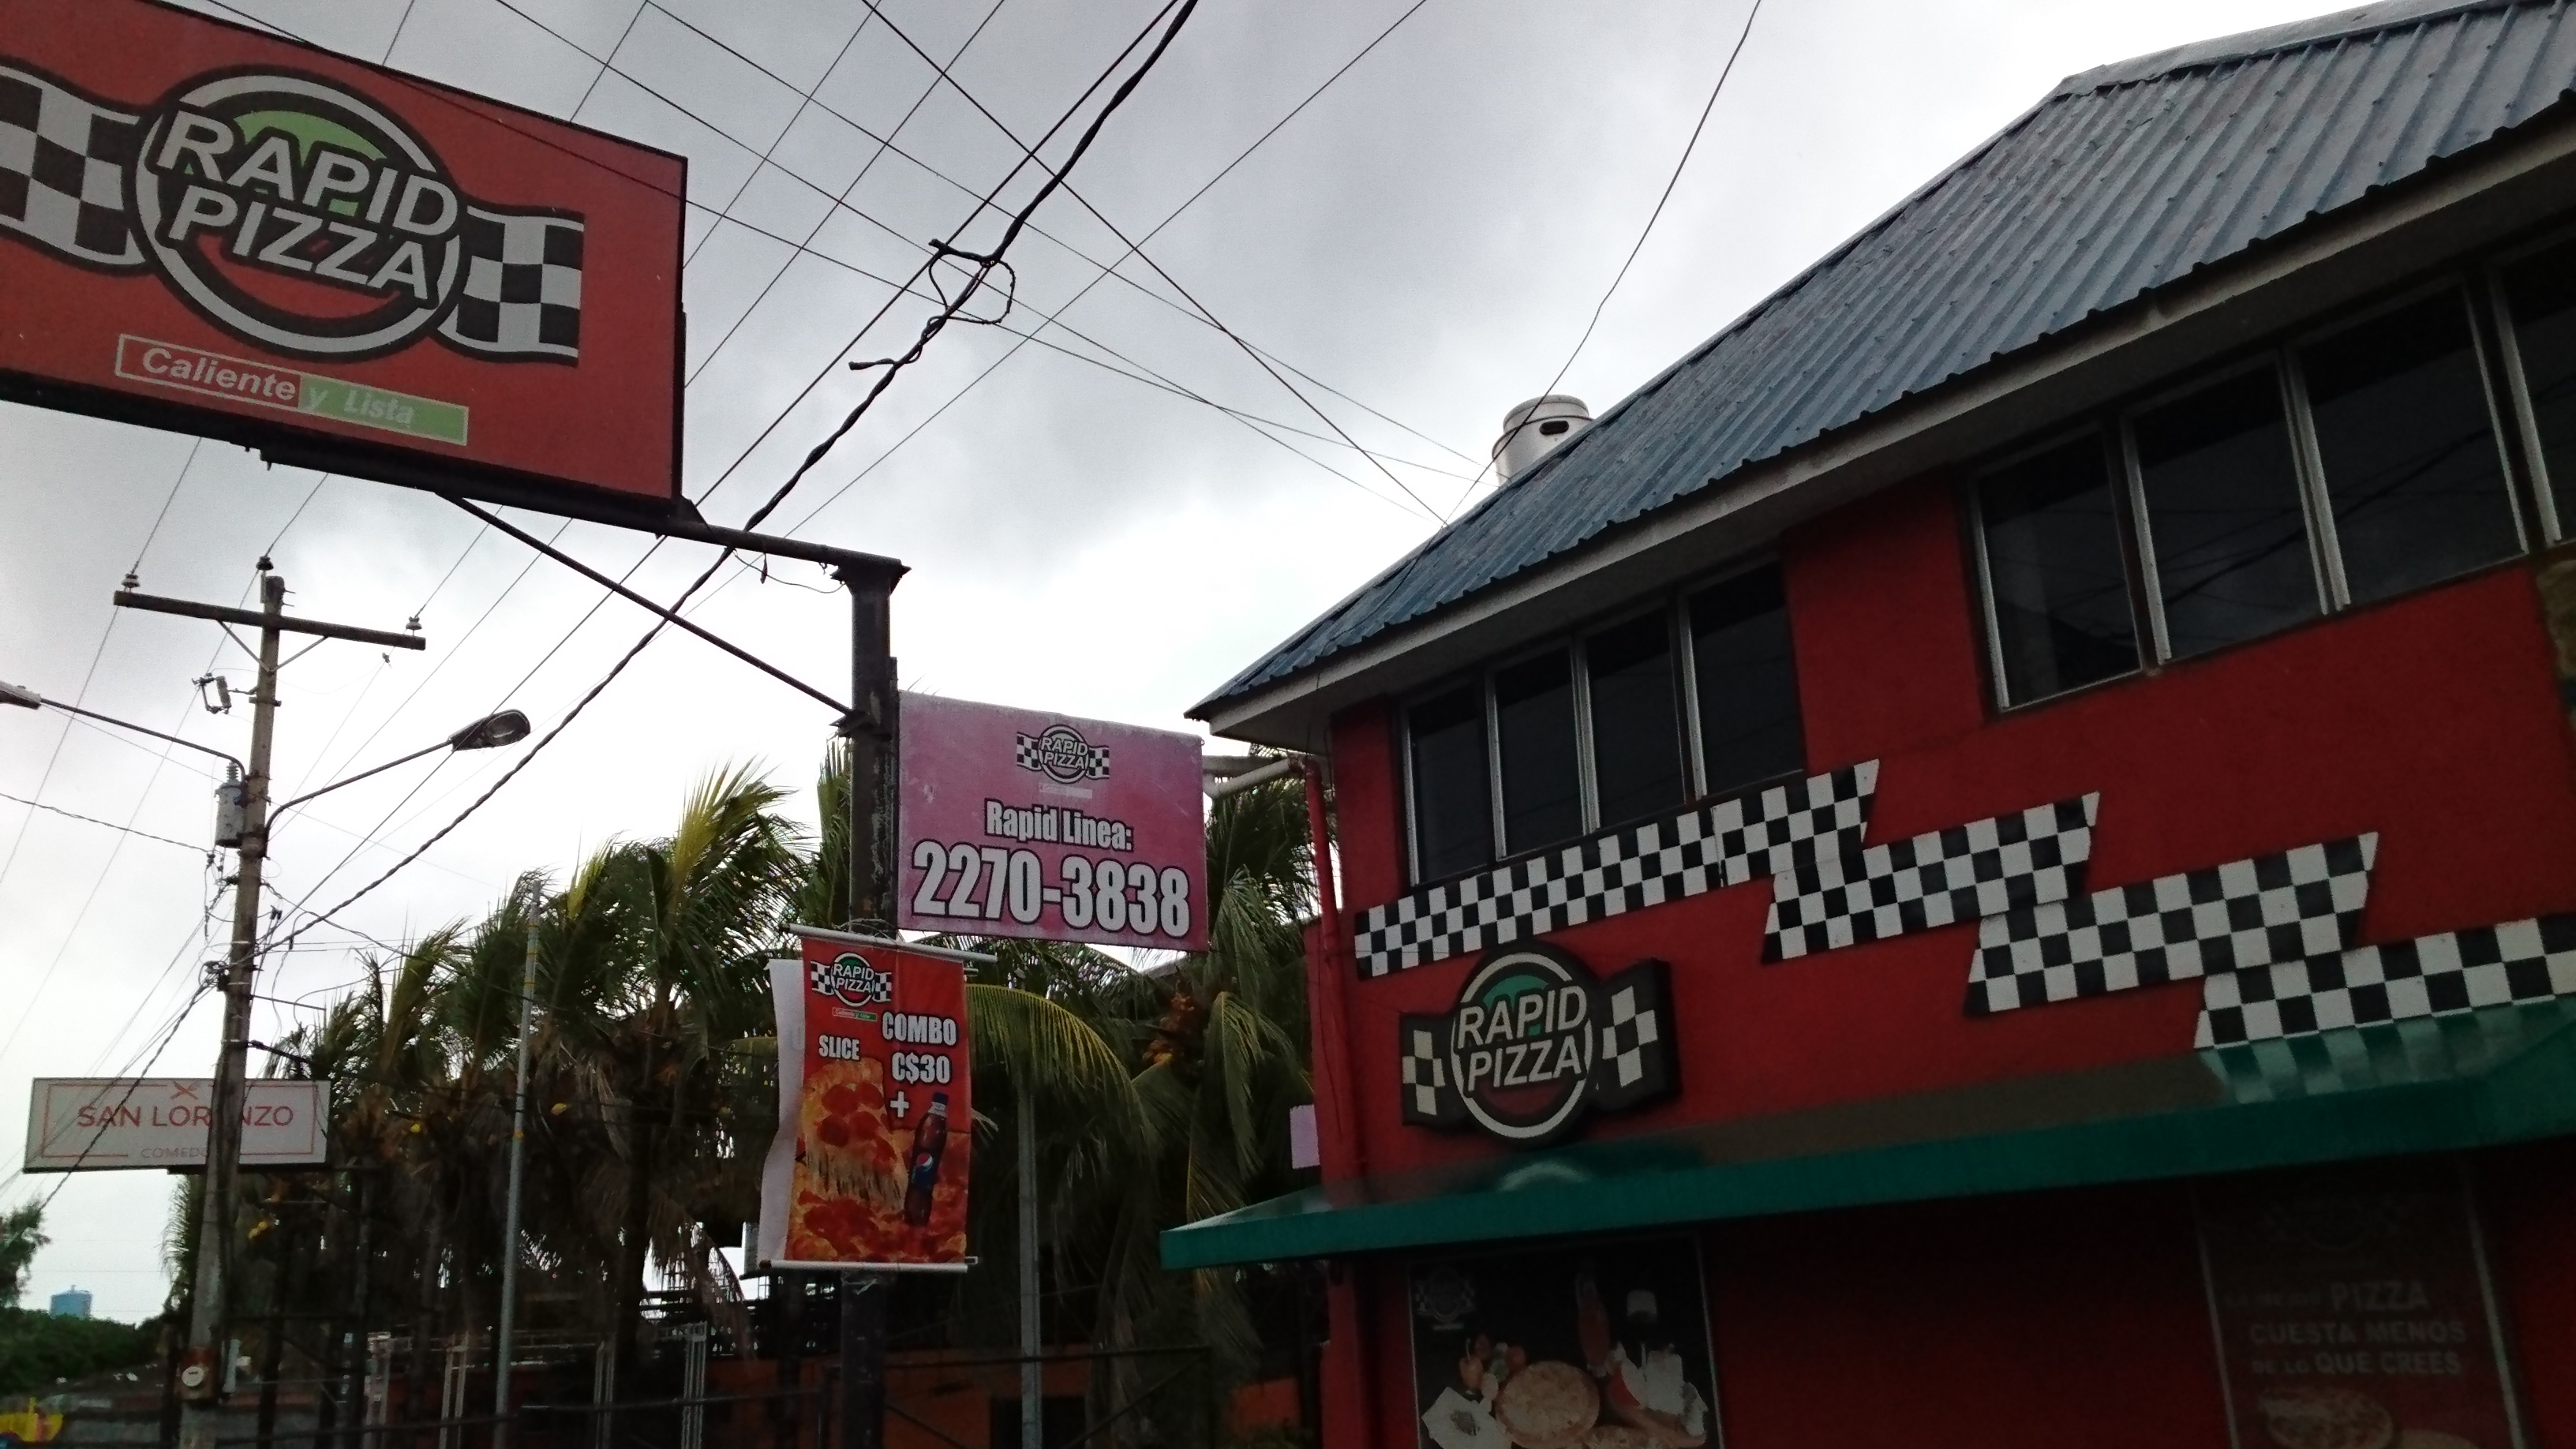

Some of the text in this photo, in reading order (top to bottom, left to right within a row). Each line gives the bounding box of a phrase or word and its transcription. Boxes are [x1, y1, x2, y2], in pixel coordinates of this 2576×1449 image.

[156, 109, 459, 238] RAPID
[168, 184, 430, 301] PIZZA
[143, 346, 414, 426] Caliente y Lista
[1040, 736, 1089, 757] RAPID
[1043, 751, 1086, 769] PIZZA
[986, 800, 1133, 852] Rapid Linea:
[912, 839, 1191, 938] 2270-3838
[833, 963, 874, 981] RAPID
[836, 977, 871, 994] PIZZA
[882, 1011, 957, 1046] COMBO
[1458, 985, 1588, 1050] RAPID
[818, 1034, 860, 1061] SLICE
[891, 1051, 951, 1084] C$30
[1468, 1035, 1582, 1092] PIZZA
[77, 1105, 294, 1128] SAN LORZO
[140, 1147, 208, 1159] COMEDO
[2330, 1280, 2429, 1311] PIZZA
[2248, 1320, 2467, 1345] CUESTA MENOS
[2313, 1351, 2372, 1376] QUE
[2379, 1351, 2462, 1375] CREES
